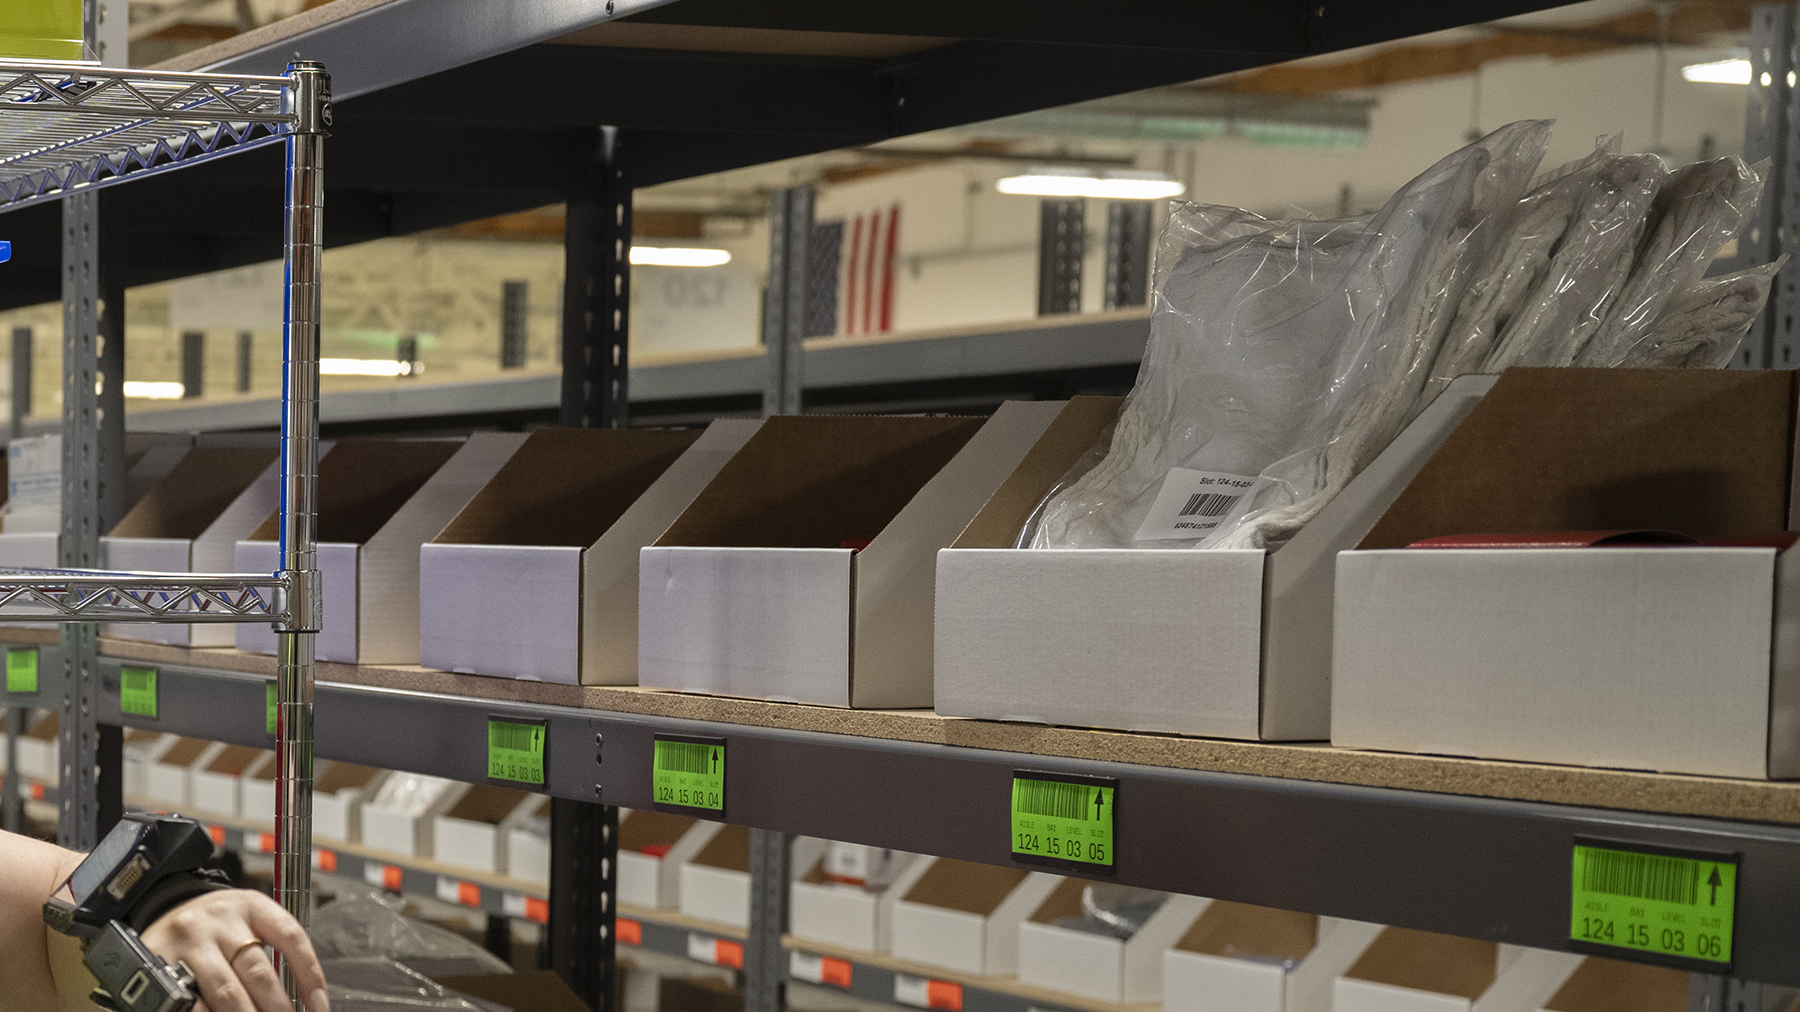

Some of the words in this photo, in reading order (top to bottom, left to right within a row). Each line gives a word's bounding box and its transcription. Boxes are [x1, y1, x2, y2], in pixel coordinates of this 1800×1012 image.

[492, 762, 504, 776] 124
[508, 765, 516, 778] 15
[519, 766, 528, 780] 03
[531, 768, 540, 782] 03
[659, 787, 674, 801] 124
[679, 789, 689, 803] 15
[693, 791, 704, 805] 03
[708, 792, 719, 807] 04
[1020, 820, 1034, 829] AISLE
[1046, 824, 1057, 832] BAY
[1066, 826, 1081, 835] LEVEL
[1090, 829, 1104, 838] SLOT
[1018, 833, 1039, 851] 124
[1046, 837, 1060, 854] 15
[1066, 840, 1081, 857] 03
[1088, 843, 1104, 861] 05
[1585, 901, 1608, 912] AISLE
[1631, 907, 1645, 917] BAY
[1662, 912, 1686, 924] LEVEL
[1701, 917, 1721, 928] SLOT
[1583, 917, 1614, 941] 124
[1628, 923, 1650, 946] 15
[1662, 928, 1685, 951] 03
[1698, 933, 1721, 957] 06
